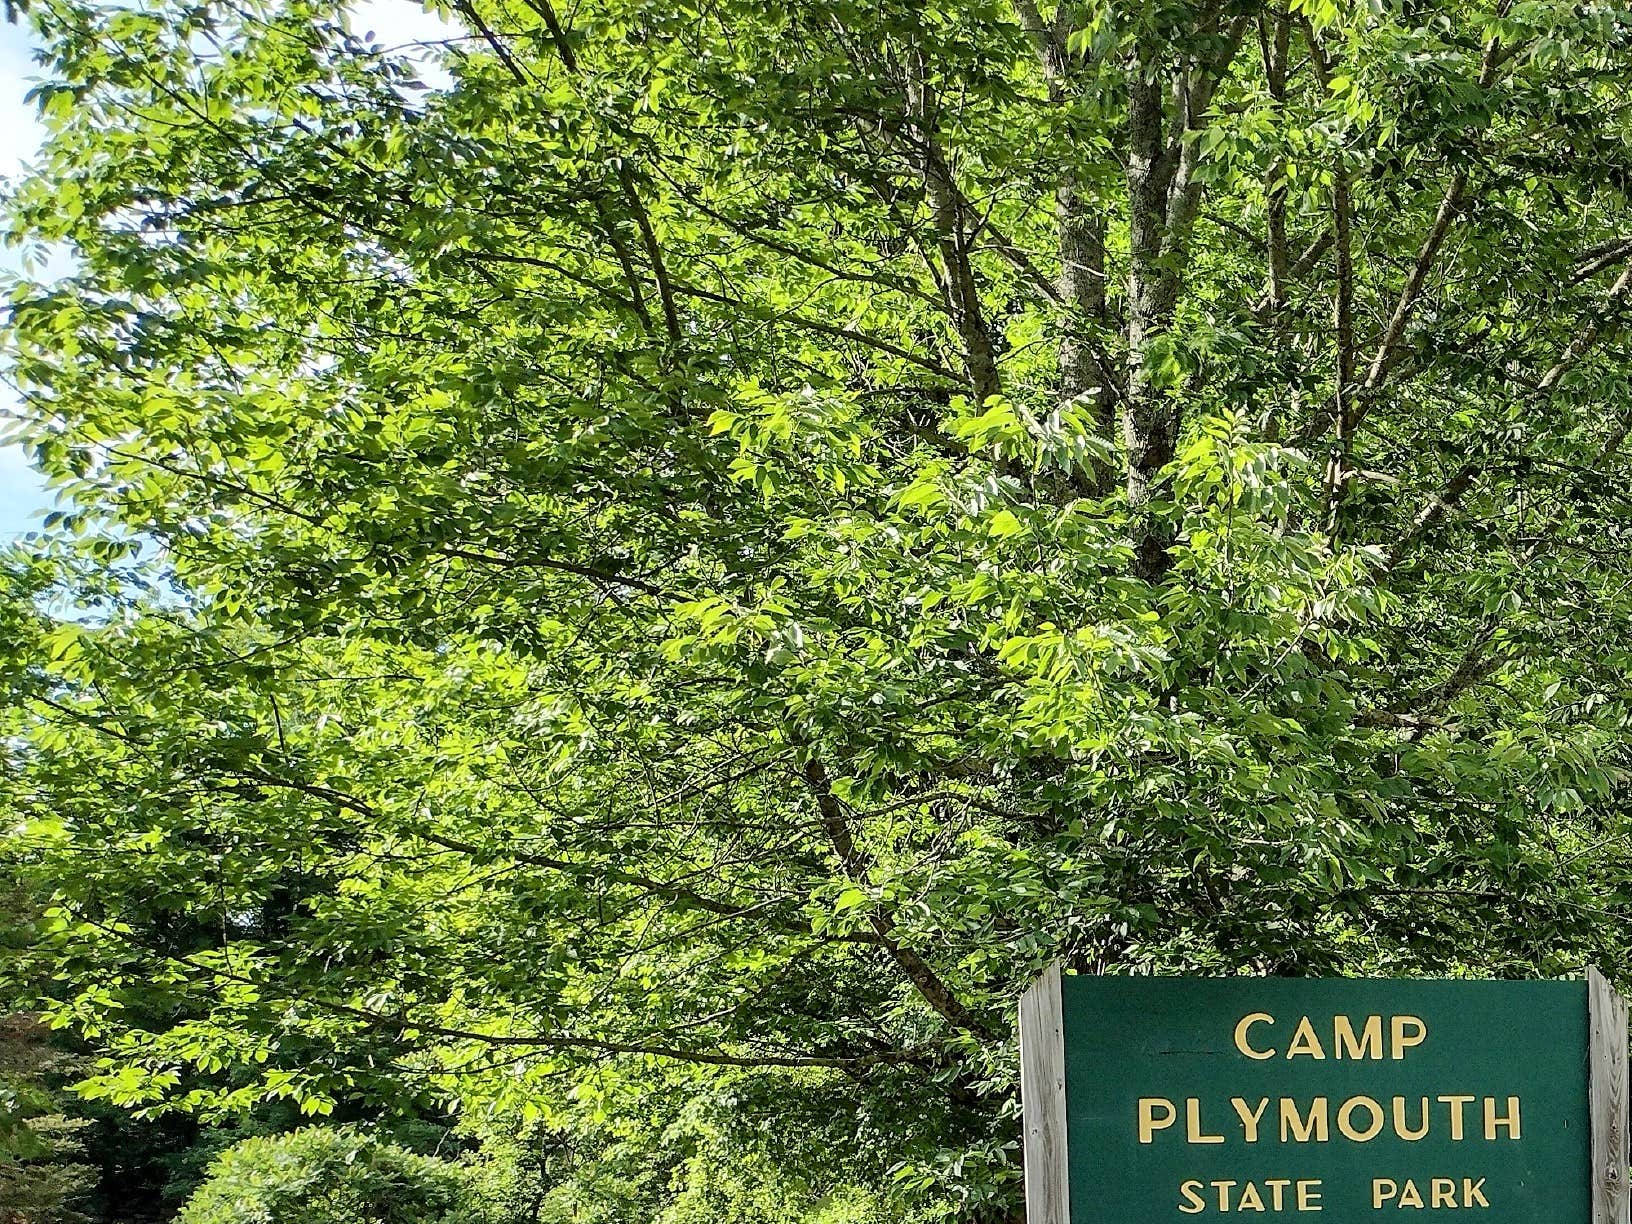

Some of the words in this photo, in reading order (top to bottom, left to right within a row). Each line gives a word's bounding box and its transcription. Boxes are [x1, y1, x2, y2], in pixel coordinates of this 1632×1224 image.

[1234, 1012, 1427, 1060] CAMP
[1138, 1095, 1521, 1144] PLYMOUTH
[1178, 1179, 1323, 1214] STATE
[1372, 1177, 1490, 1210] PARK
